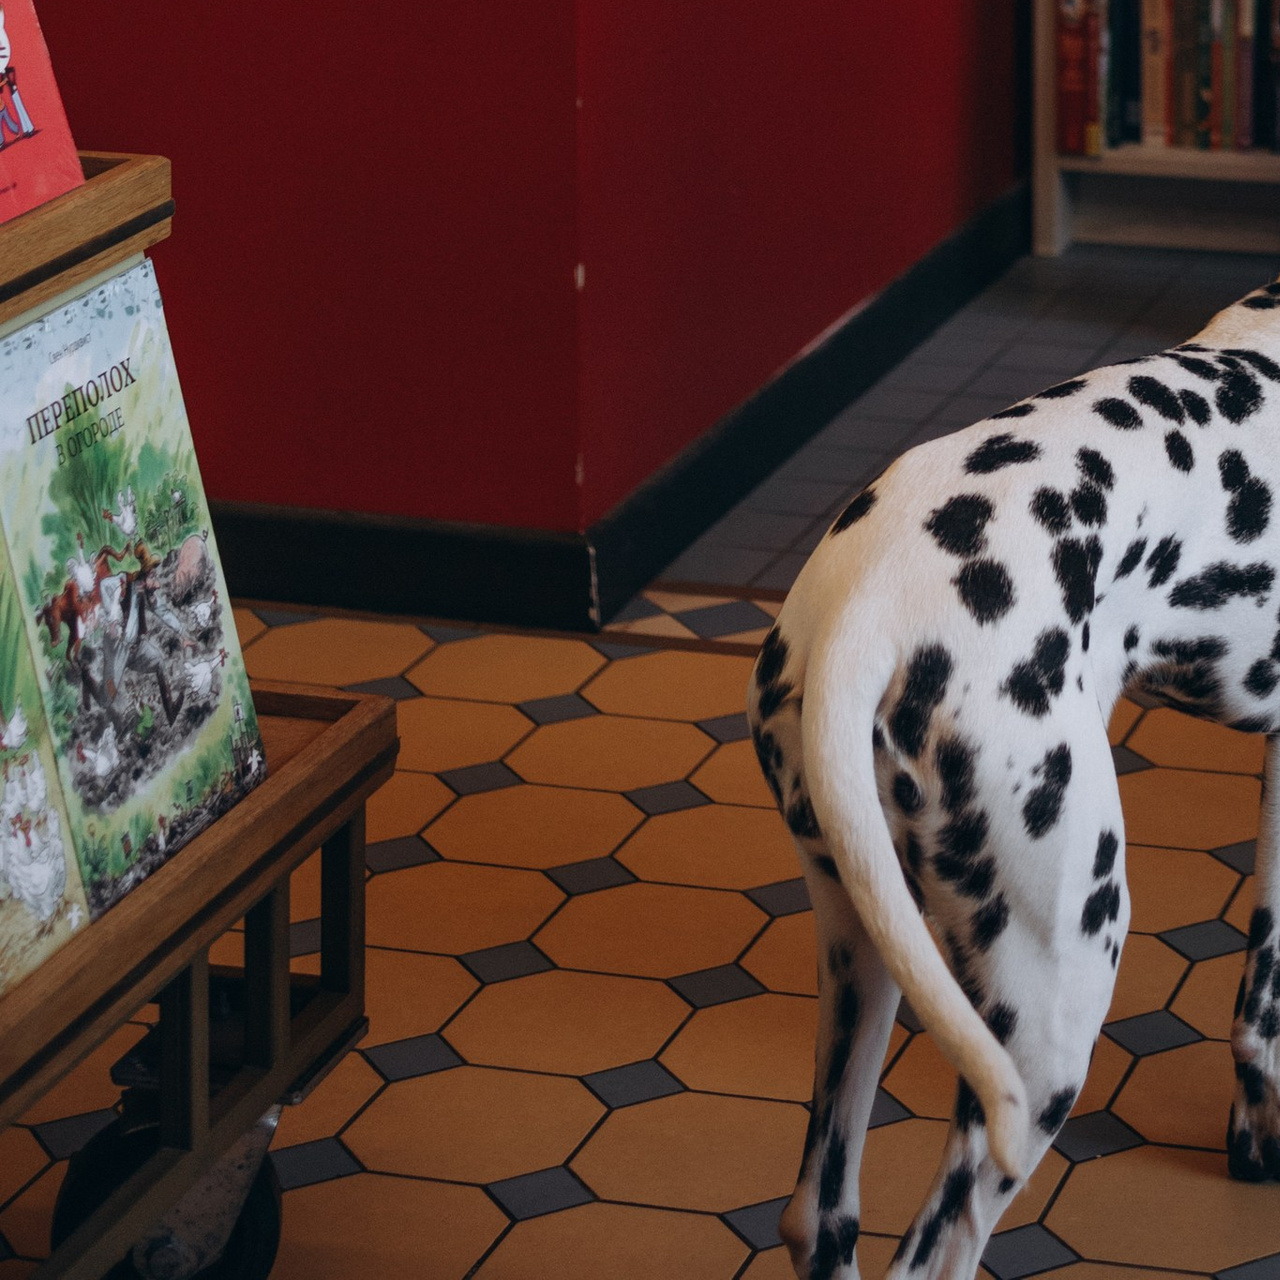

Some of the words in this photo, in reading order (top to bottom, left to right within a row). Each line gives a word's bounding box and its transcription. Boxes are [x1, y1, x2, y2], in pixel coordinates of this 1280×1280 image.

[26, 357, 137, 445] ПЕРЕПОЛОХ
[56, 444, 67, 466] В
[67, 407, 126, 458] ОГОРОДЕ
